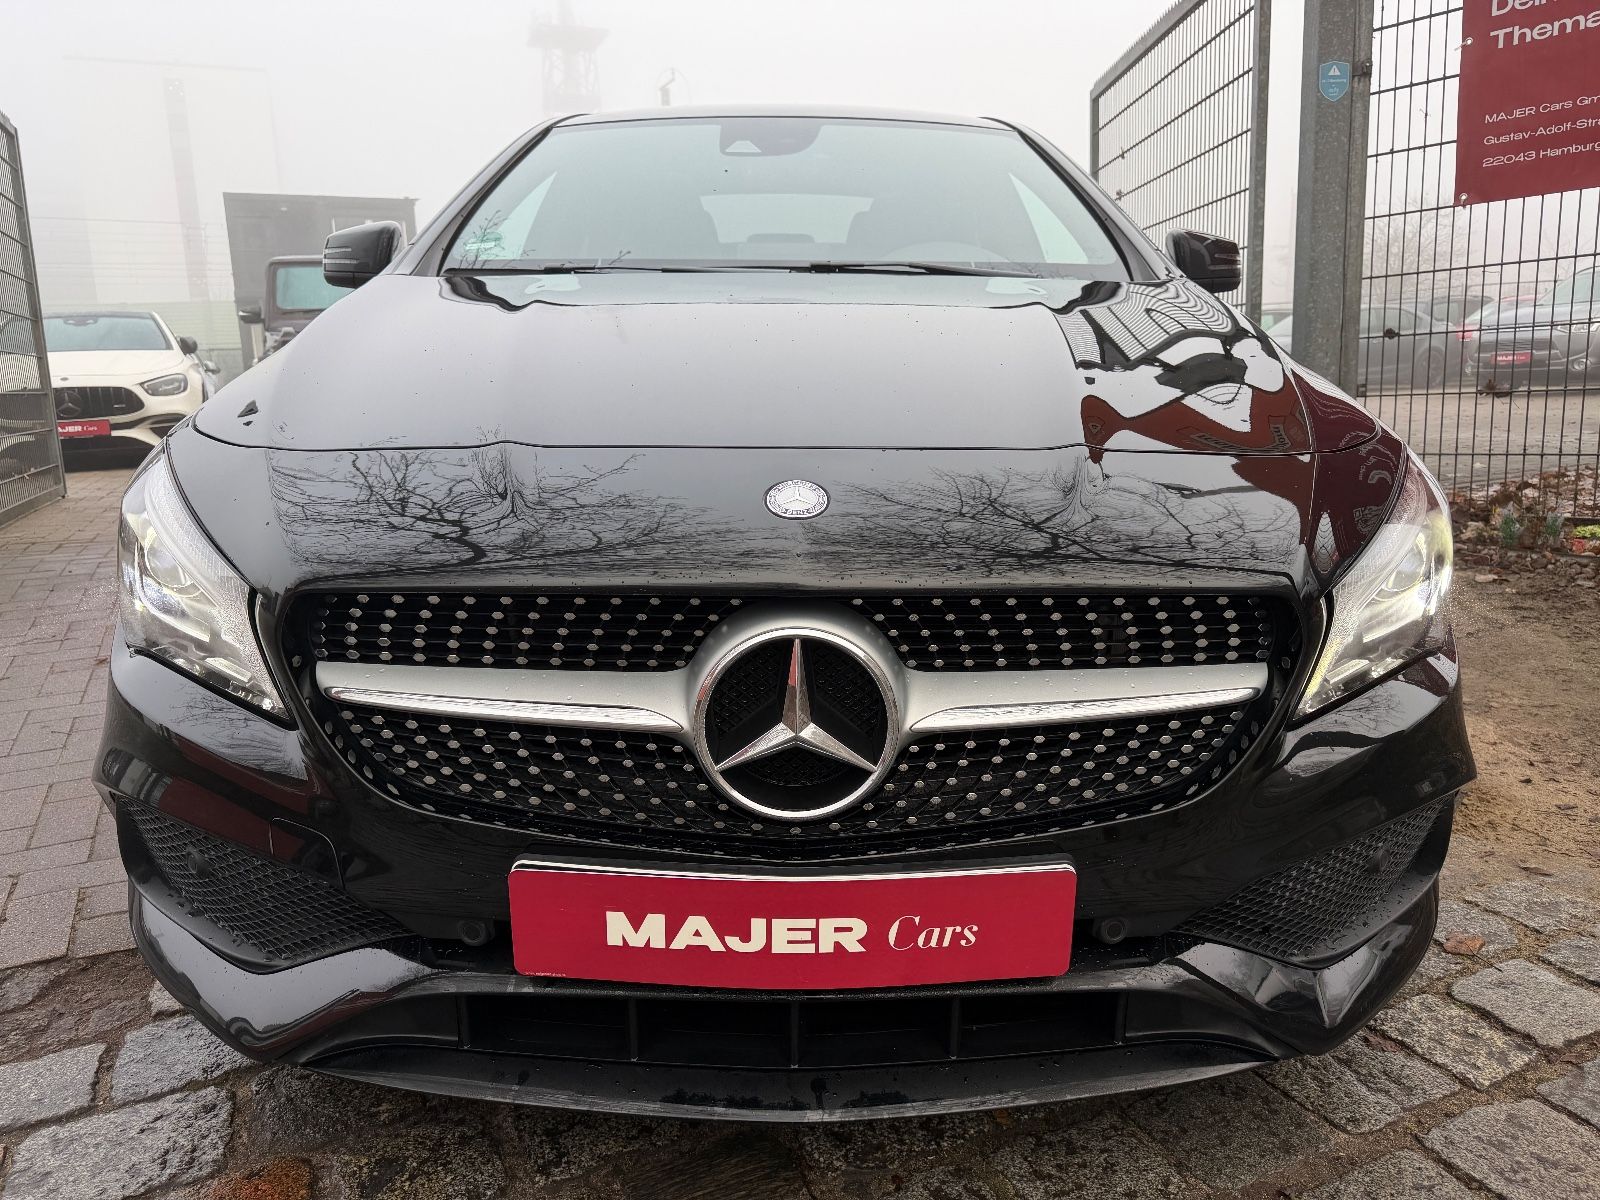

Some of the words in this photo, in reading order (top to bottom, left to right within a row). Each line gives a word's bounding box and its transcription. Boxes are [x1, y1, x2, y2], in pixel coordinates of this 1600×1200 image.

[1491, 0, 1547, 16] De
[1489, 10, 1600, 49] Thema
[1484, 106, 1536, 124] MAJER
[1539, 100, 1573, 113] Cars
[1482, 150, 1536, 168] 22043
[606, 911, 867, 954] MAJER
[888, 915, 978, 950] Cars
